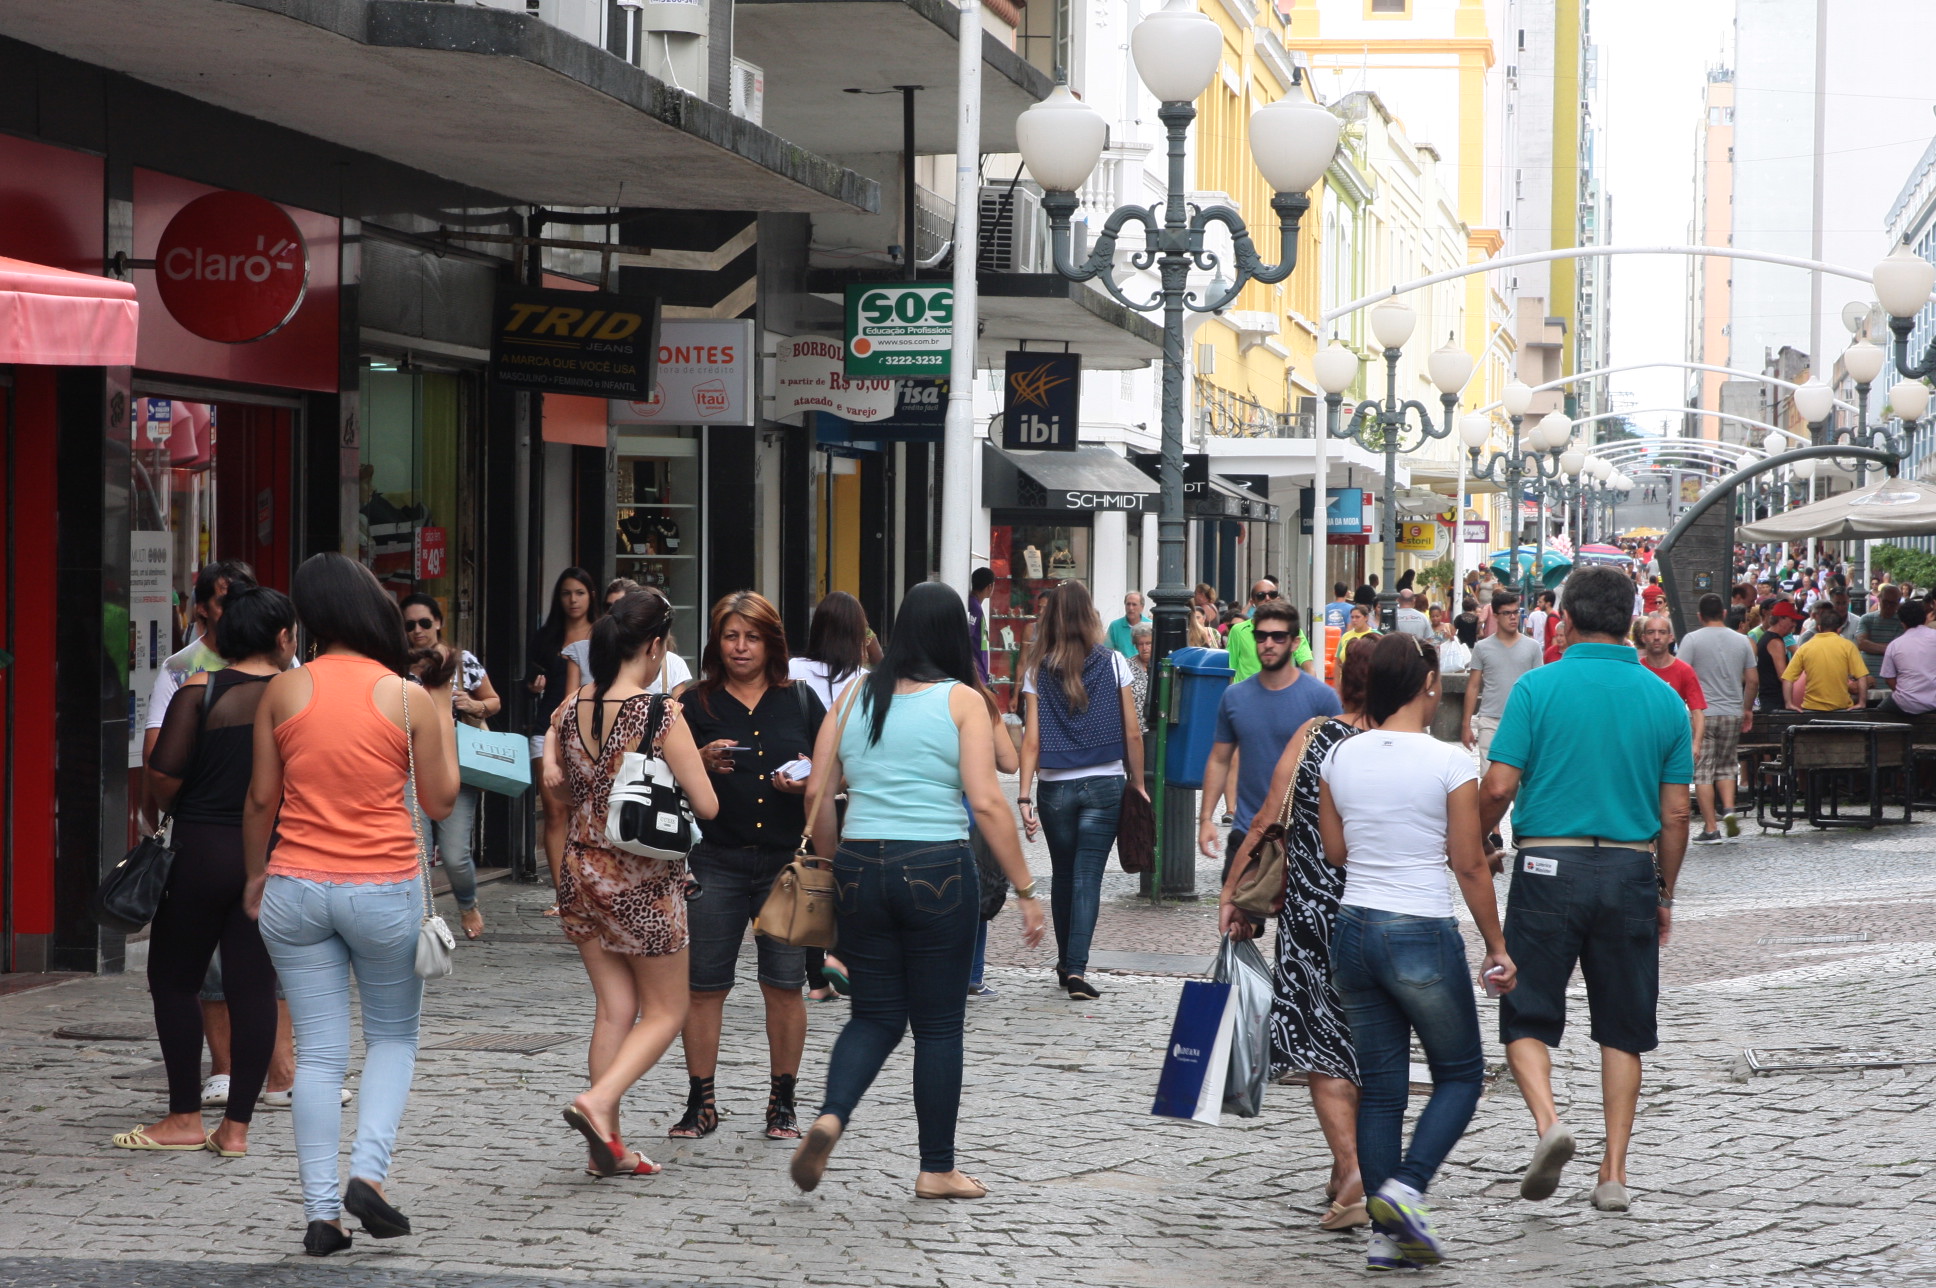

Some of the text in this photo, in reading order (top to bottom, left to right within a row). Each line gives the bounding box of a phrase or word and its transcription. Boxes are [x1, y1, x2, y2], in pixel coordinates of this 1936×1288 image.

[164, 246, 271, 283] Claro
[503, 303, 643, 341] TRID
[866, 327, 906, 336] Educação
[586, 342, 634, 354] JEANS
[877, 338, 940, 346] www.sos.com.br
[501, 353, 637, 375] A MARCA QUE VOCÊ USA
[885, 355, 943, 365] 3222-3232
[683, 366, 695, 374] de
[697, 366, 735, 374] crédito
[500, 371, 548, 384] MASCULINO
[554, 376, 593, 388] FEMININO
[602, 382, 637, 392] INFANTIL
[788, 377, 813, 386] partir
[815, 377, 826, 386] de
[697, 392, 725, 405] Itaú
[793, 396, 877, 418] atacado e varejo
[1019, 414, 1060, 444] ibi
[1066, 491, 1149, 510] SCHMIDT
[1343, 517, 1360, 526] MODA
[472, 741, 518, 759] OUTLET
